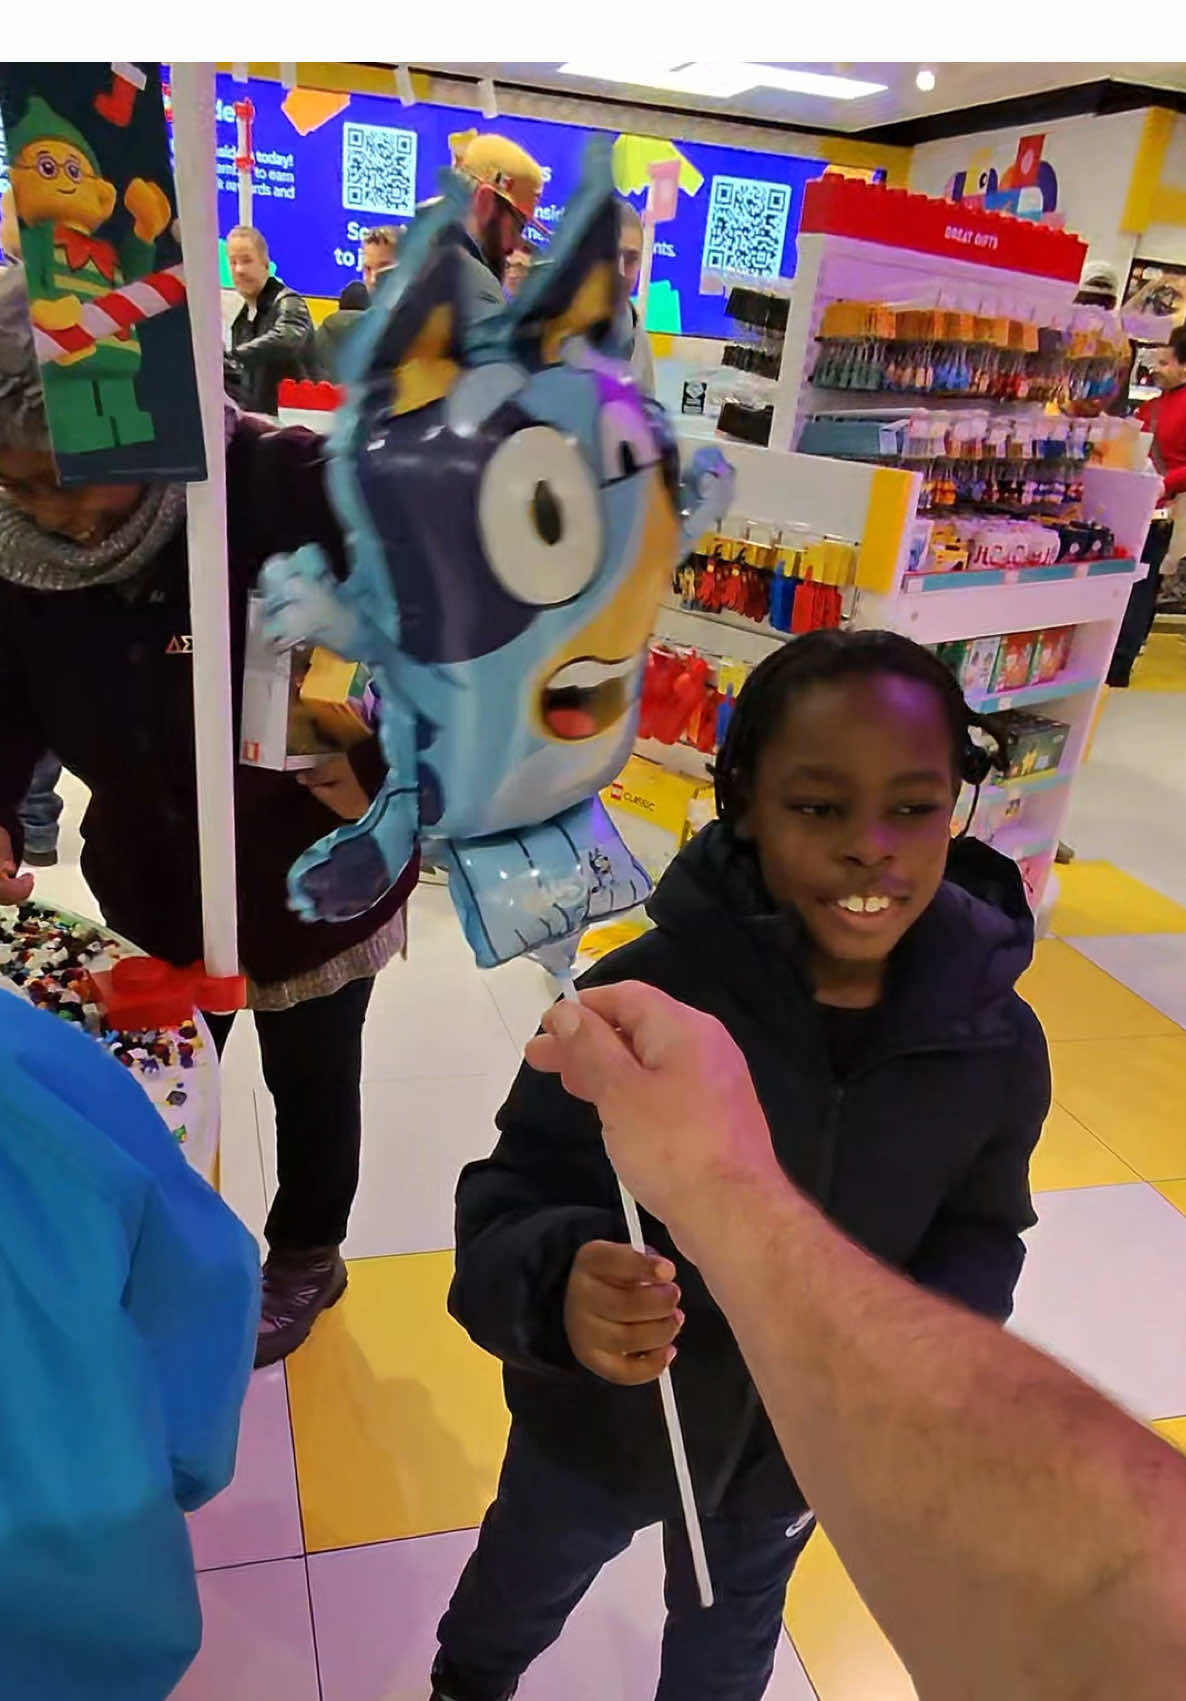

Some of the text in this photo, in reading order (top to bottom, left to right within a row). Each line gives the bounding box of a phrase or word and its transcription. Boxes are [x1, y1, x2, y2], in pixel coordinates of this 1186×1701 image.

[256, 151, 294, 168] today!
[255, 167, 295, 183] to earn
[273, 186, 296, 200] and
[334, 247, 355, 266] to
